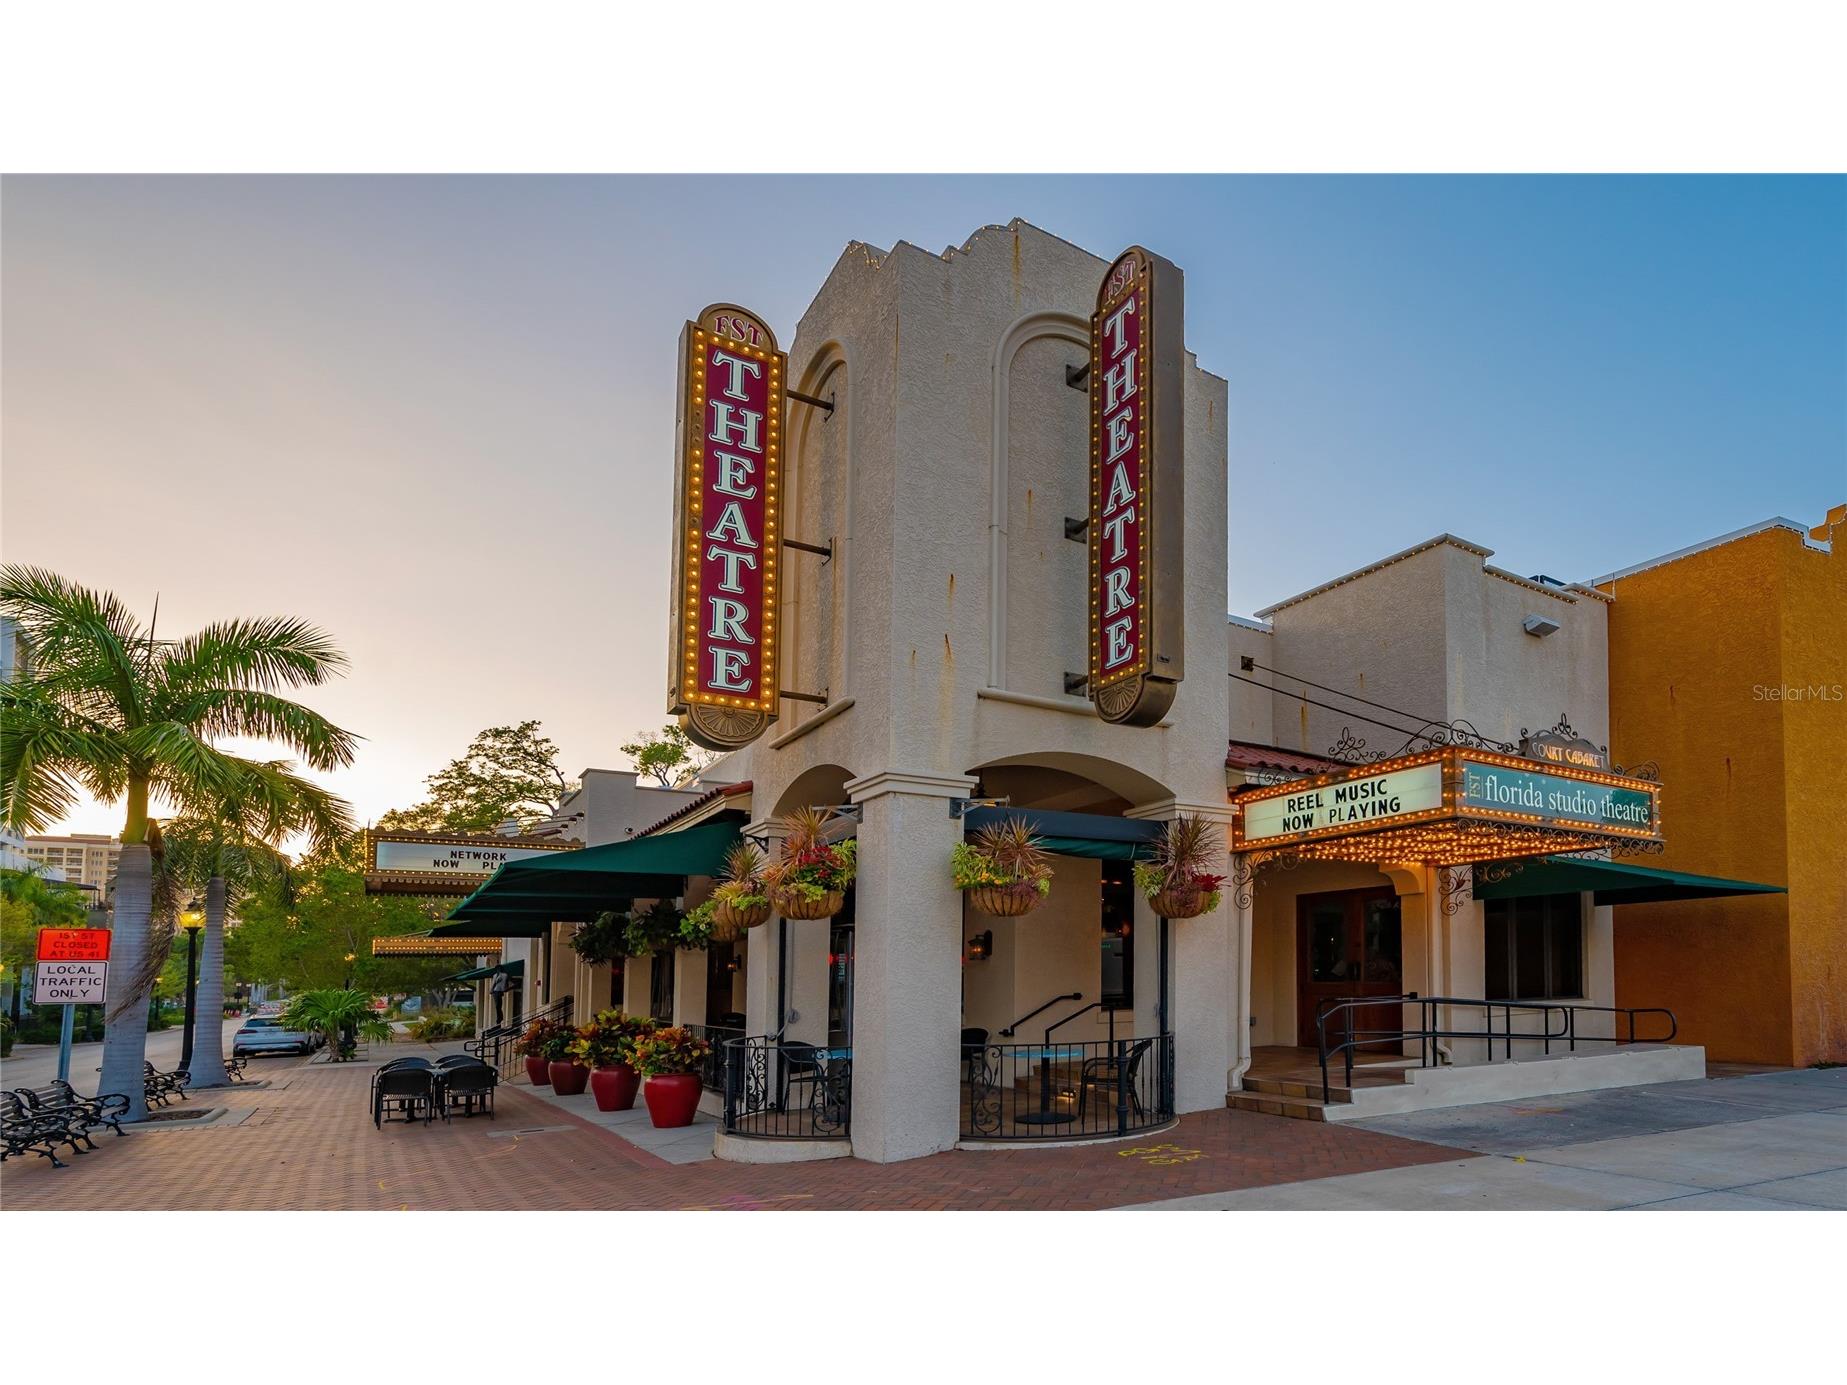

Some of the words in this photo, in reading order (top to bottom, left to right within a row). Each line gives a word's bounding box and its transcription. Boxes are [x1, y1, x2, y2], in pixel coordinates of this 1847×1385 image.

[1103, 260, 1136, 305] FST
[713, 315, 764, 348] FST
[1101, 296, 1138, 670] THEATRE
[706, 349, 763, 694] THEATRE
[1532, 742, 1563, 762] COURT
[1565, 748, 1605, 769] CABARET
[1287, 792, 1324, 813] REEL
[1335, 779, 1388, 804] MUSIC
[1469, 771, 1482, 799] FST
[1485, 775, 1544, 808] florida
[1548, 789, 1597, 816] studio
[1600, 795, 1649, 823] theatre
[1282, 812, 1314, 832] NOW
[1329, 796, 1401, 824] PLAYING
[433, 859, 460, 868] NOW
[482, 861, 504, 870] PL
[450, 850, 507, 861] NETWORK
[53, 941, 98, 949] CLOSED
[40, 977, 102, 986] TRAFFIC
[47, 965, 96, 974] LOCAL
[49, 989, 90, 998] ONLY
